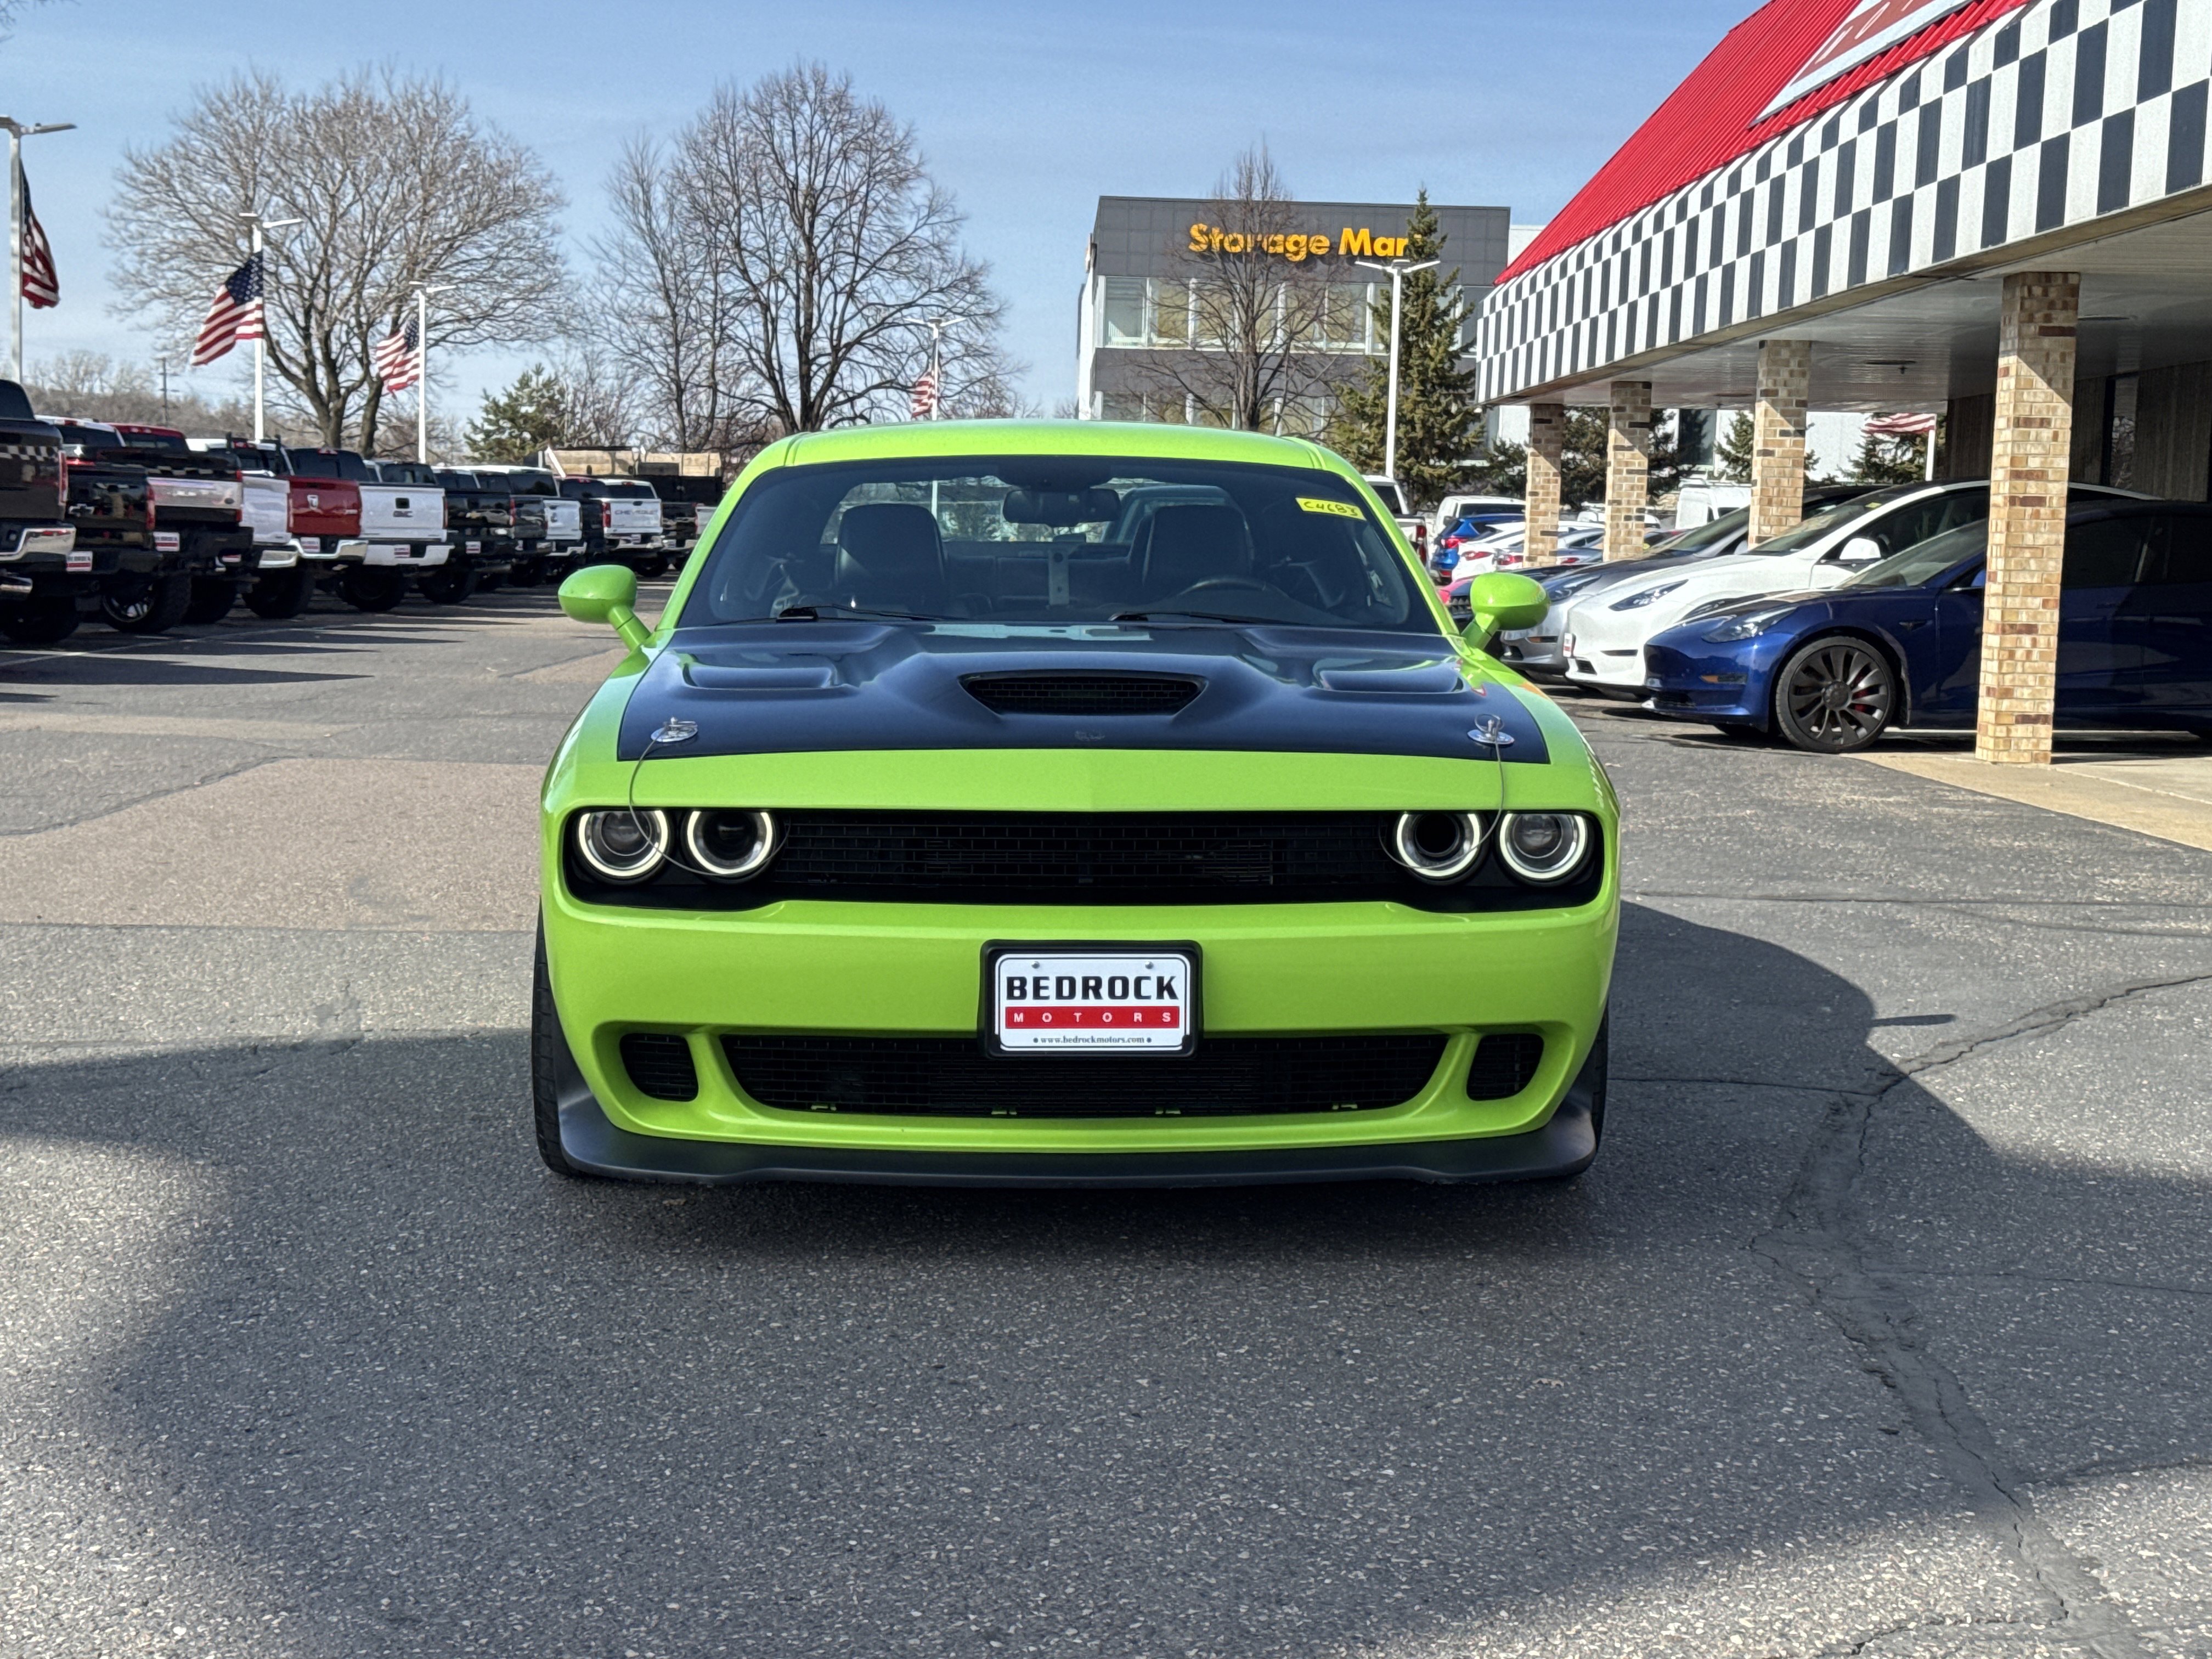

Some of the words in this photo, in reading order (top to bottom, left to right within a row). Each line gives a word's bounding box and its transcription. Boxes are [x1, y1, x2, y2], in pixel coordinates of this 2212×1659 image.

[1188, 223, 1330, 262] Storage
[1338, 227, 1423, 257] Mar
[1006, 976, 1179, 1001] BEDROCK
[1013, 1012, 1172, 1023] MOTORS
[1040, 1035, 1144, 1044] www.bedrockmotors.com
